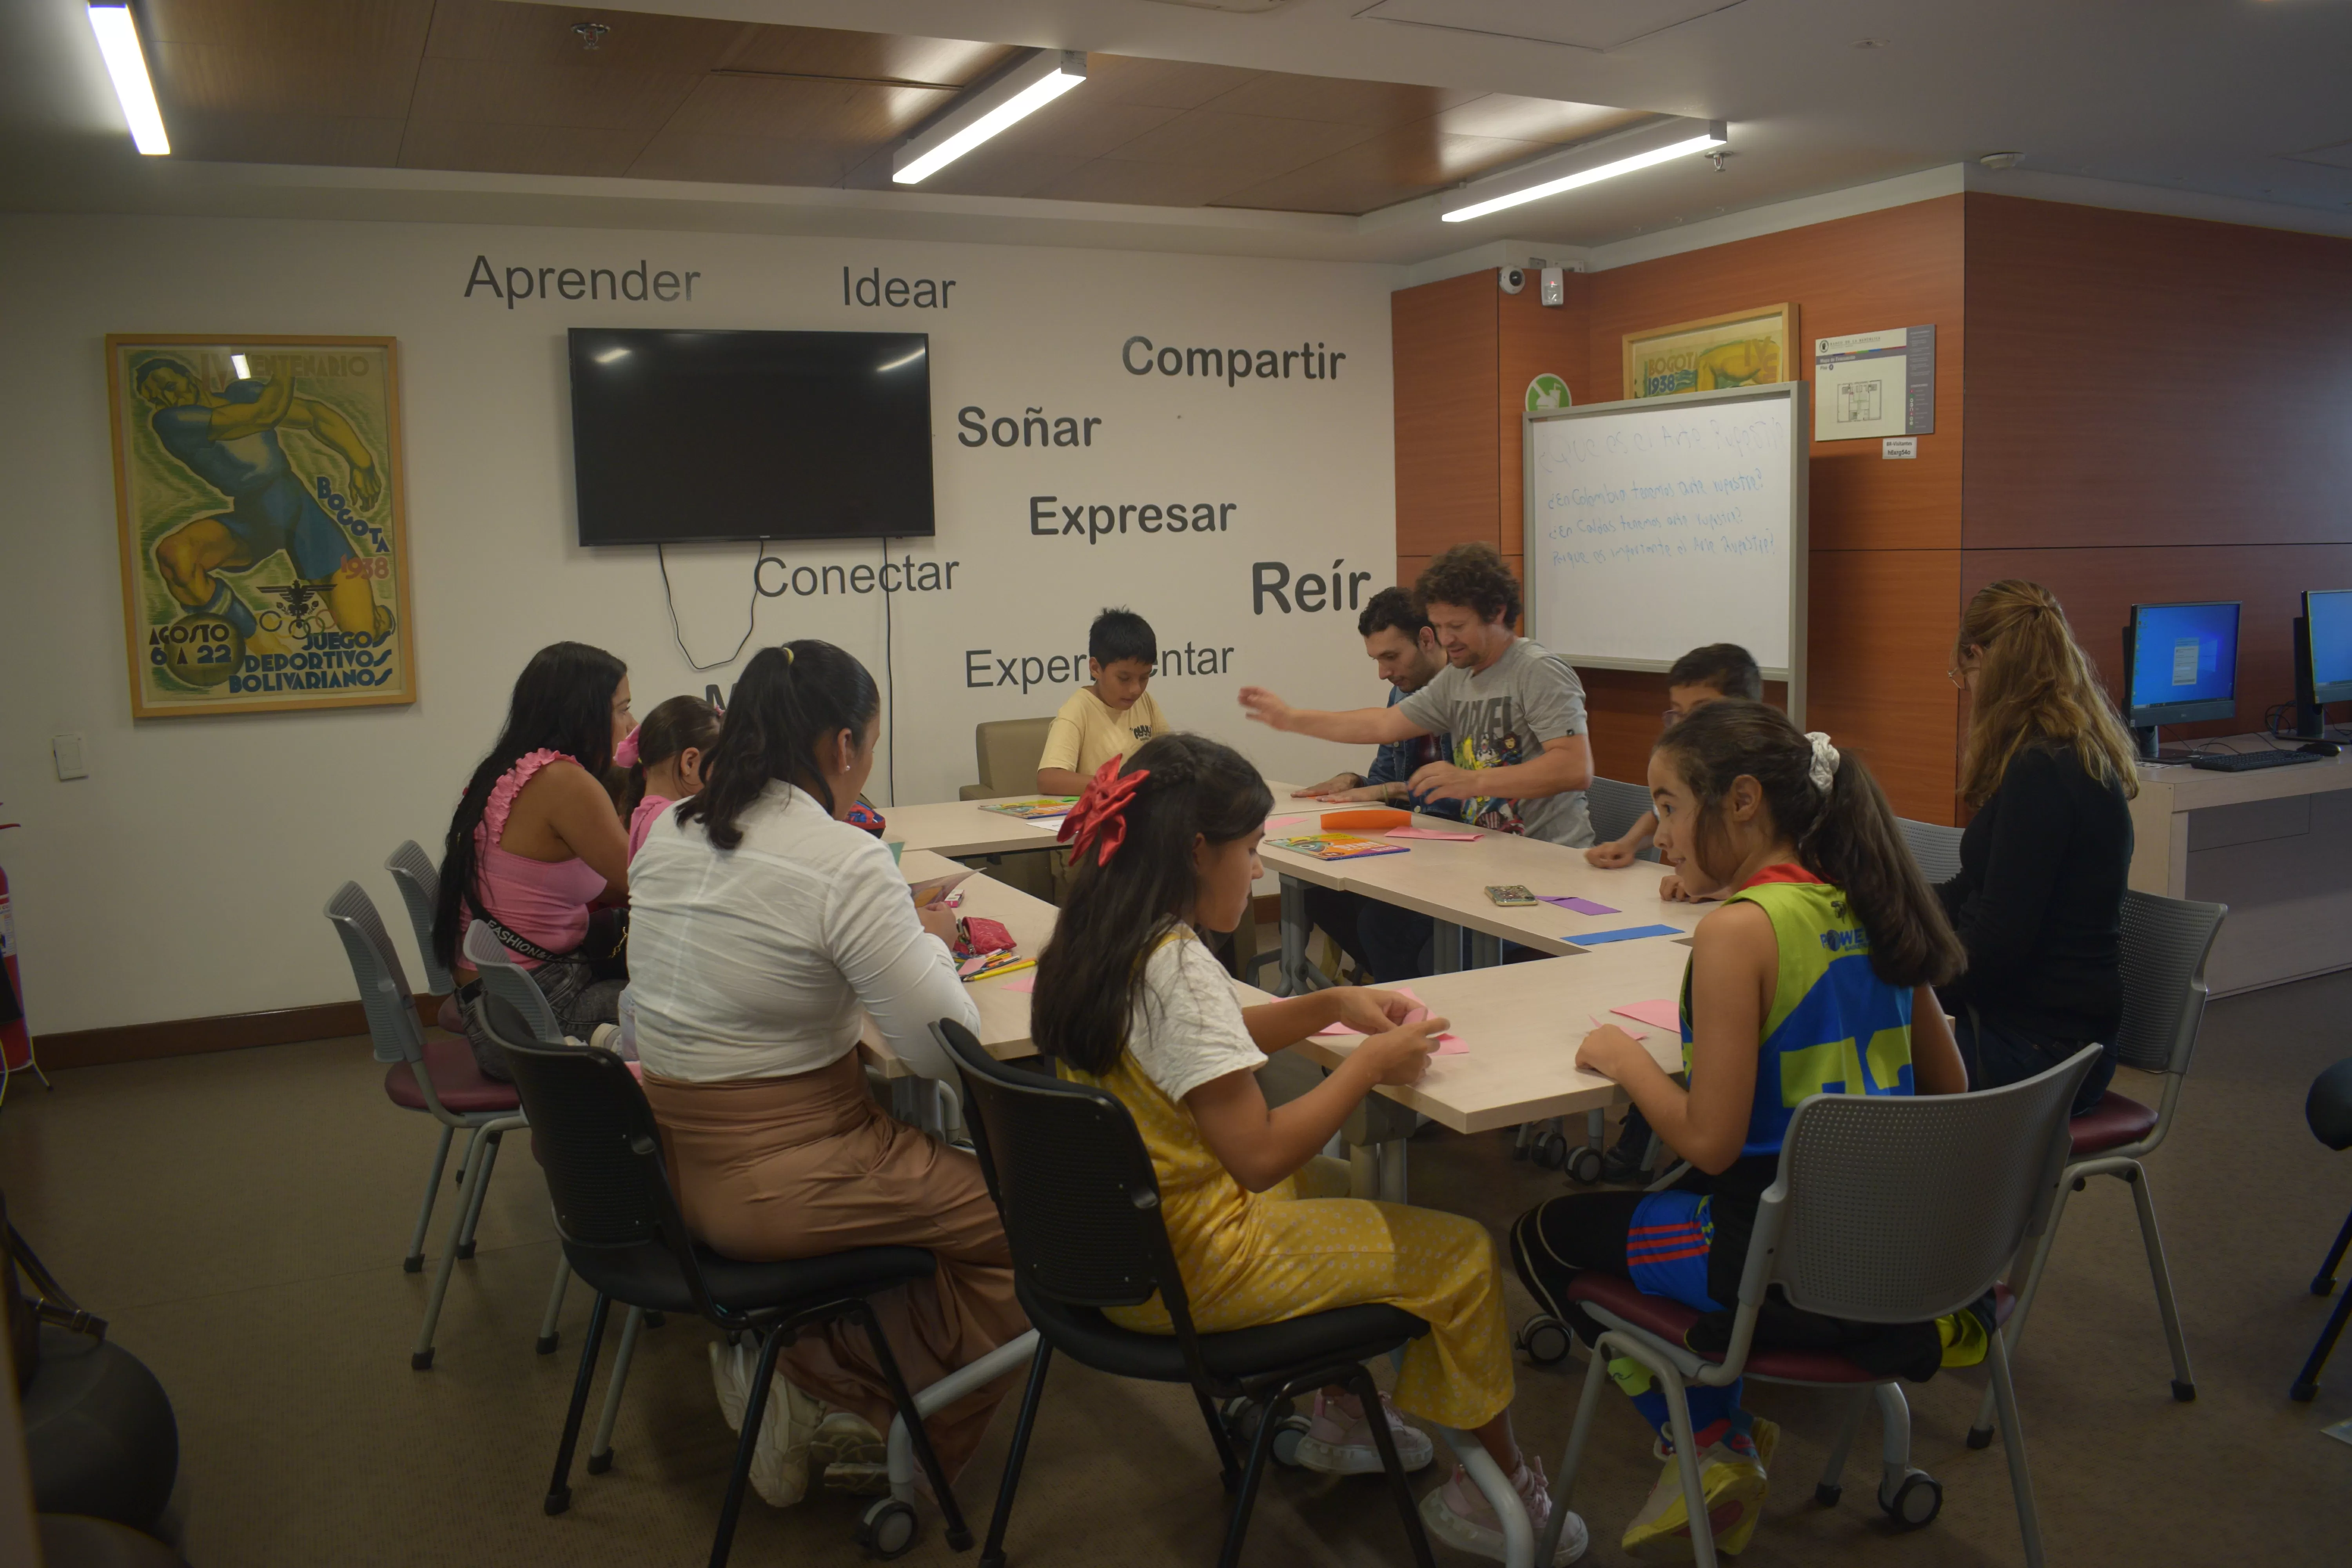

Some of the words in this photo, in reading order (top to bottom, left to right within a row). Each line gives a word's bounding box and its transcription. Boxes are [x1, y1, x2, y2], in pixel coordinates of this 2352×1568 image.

[464, 255, 701, 309] Aprender
[843, 266, 956, 309] Idear
[1122, 336, 1346, 387] Compartir
[1648, 374, 1675, 395] 1938
[957, 405, 1102, 447] Soñar
[317, 476, 390, 552] BOGOTA
[1030, 495, 1237, 545] Expresar
[340, 553, 389, 580] 1938
[754, 554, 960, 597] Conectar
[1252, 559, 1371, 615] Reír
[149, 624, 230, 645] AGOSTO
[151, 647, 167, 666] 6
[176, 647, 188, 664] A
[197, 644, 232, 664] 22
[301, 630, 392, 651] JUEGOS
[229, 668, 393, 693] BOLIVARIANOS
[244, 649, 392, 673] DEPORTIVOS
